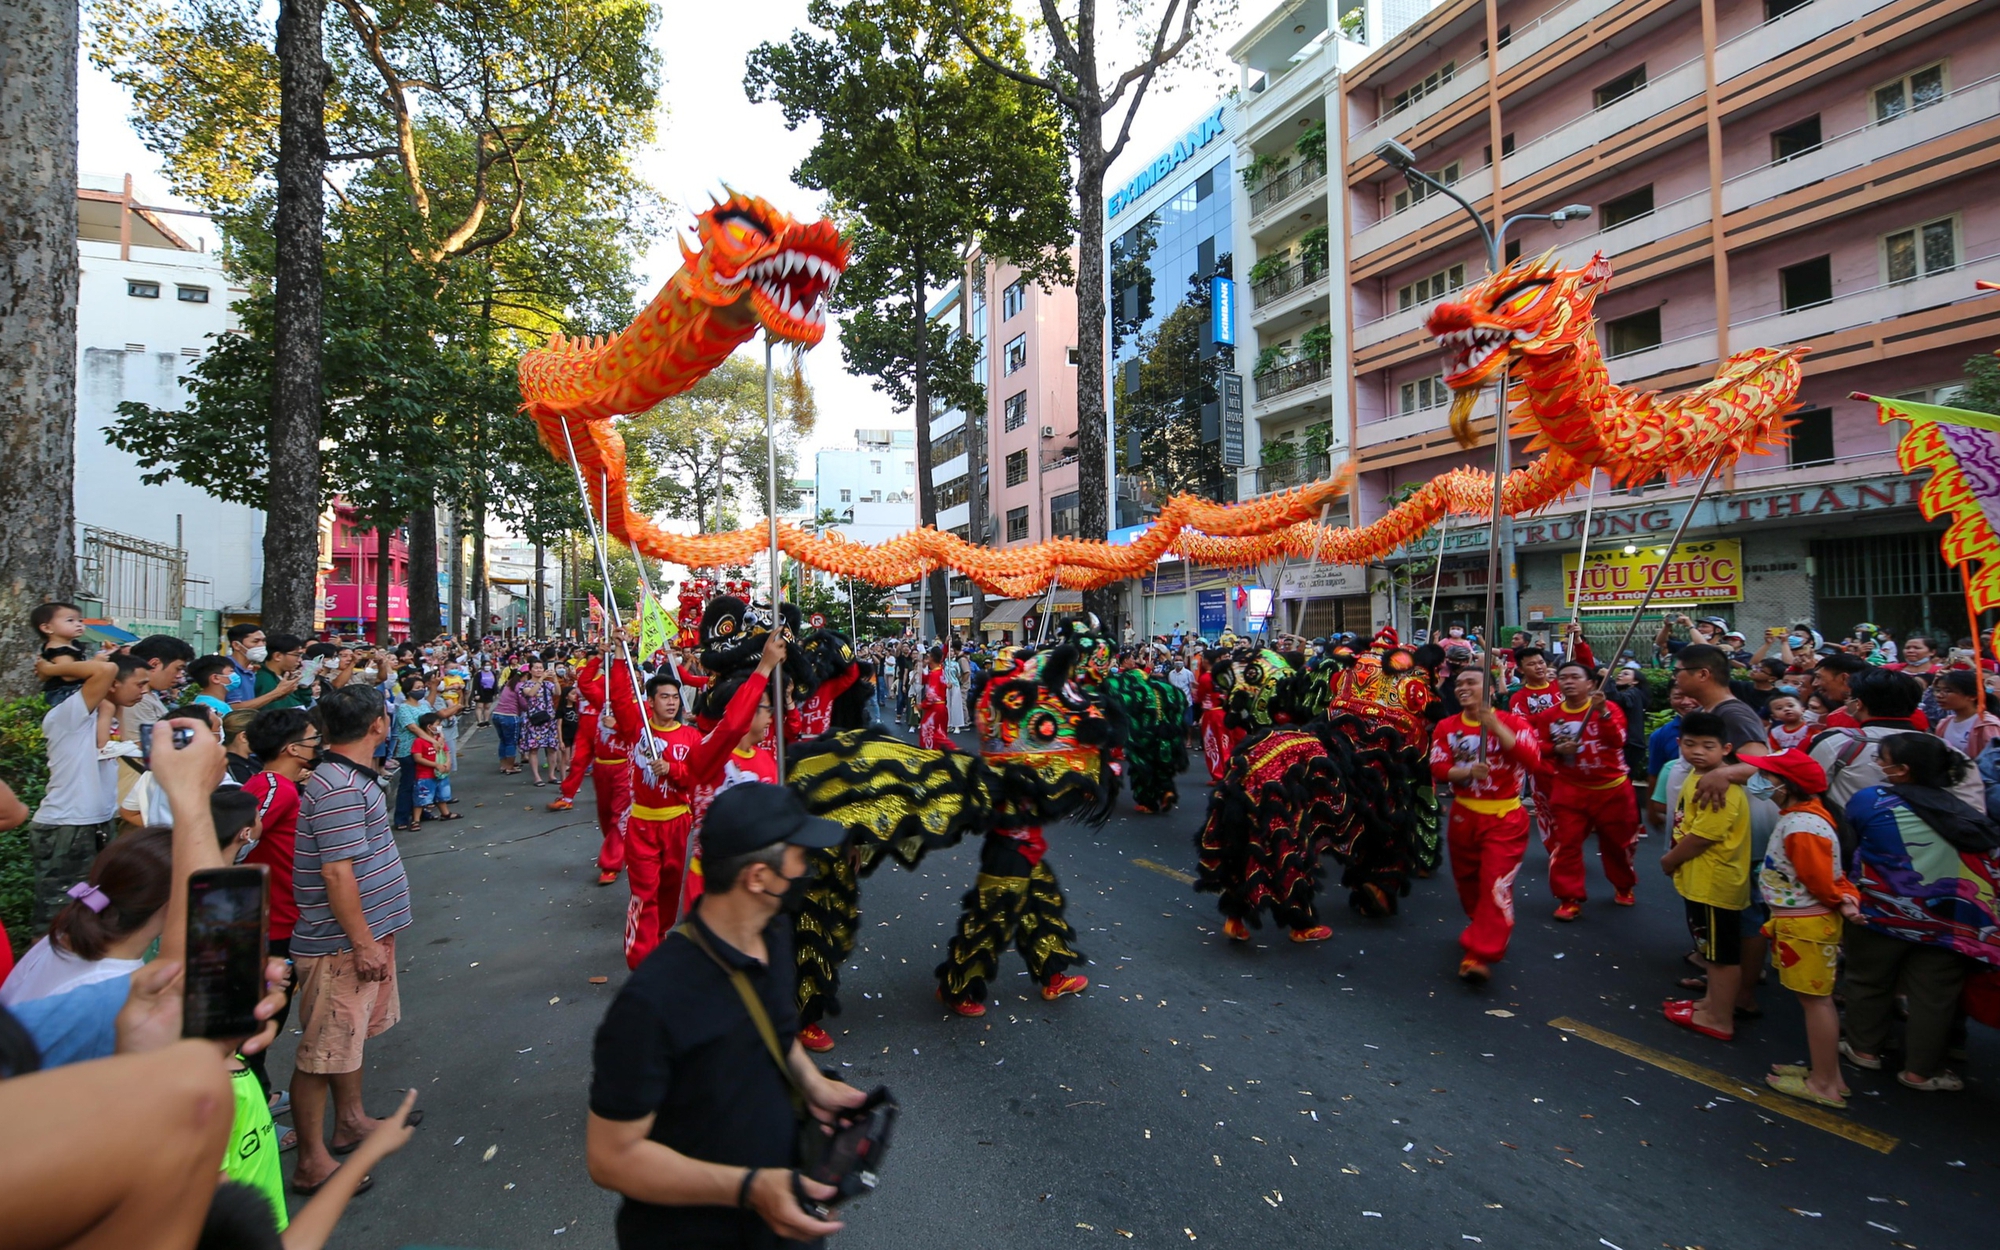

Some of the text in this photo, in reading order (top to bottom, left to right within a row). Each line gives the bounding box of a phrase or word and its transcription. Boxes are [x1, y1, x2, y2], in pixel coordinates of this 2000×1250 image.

[1108, 106, 1225, 220] EXIMBANK
[1221, 281, 1229, 340] EXIMBANK
[1229, 384, 1240, 395] TAI
[1406, 531, 1489, 554] HOTEL
[1685, 541, 1717, 554] SỐ
[1568, 554, 1736, 591] HỮU THỨC
[1597, 591, 1614, 601] SỐ
[1663, 588, 1692, 598] CÁC
